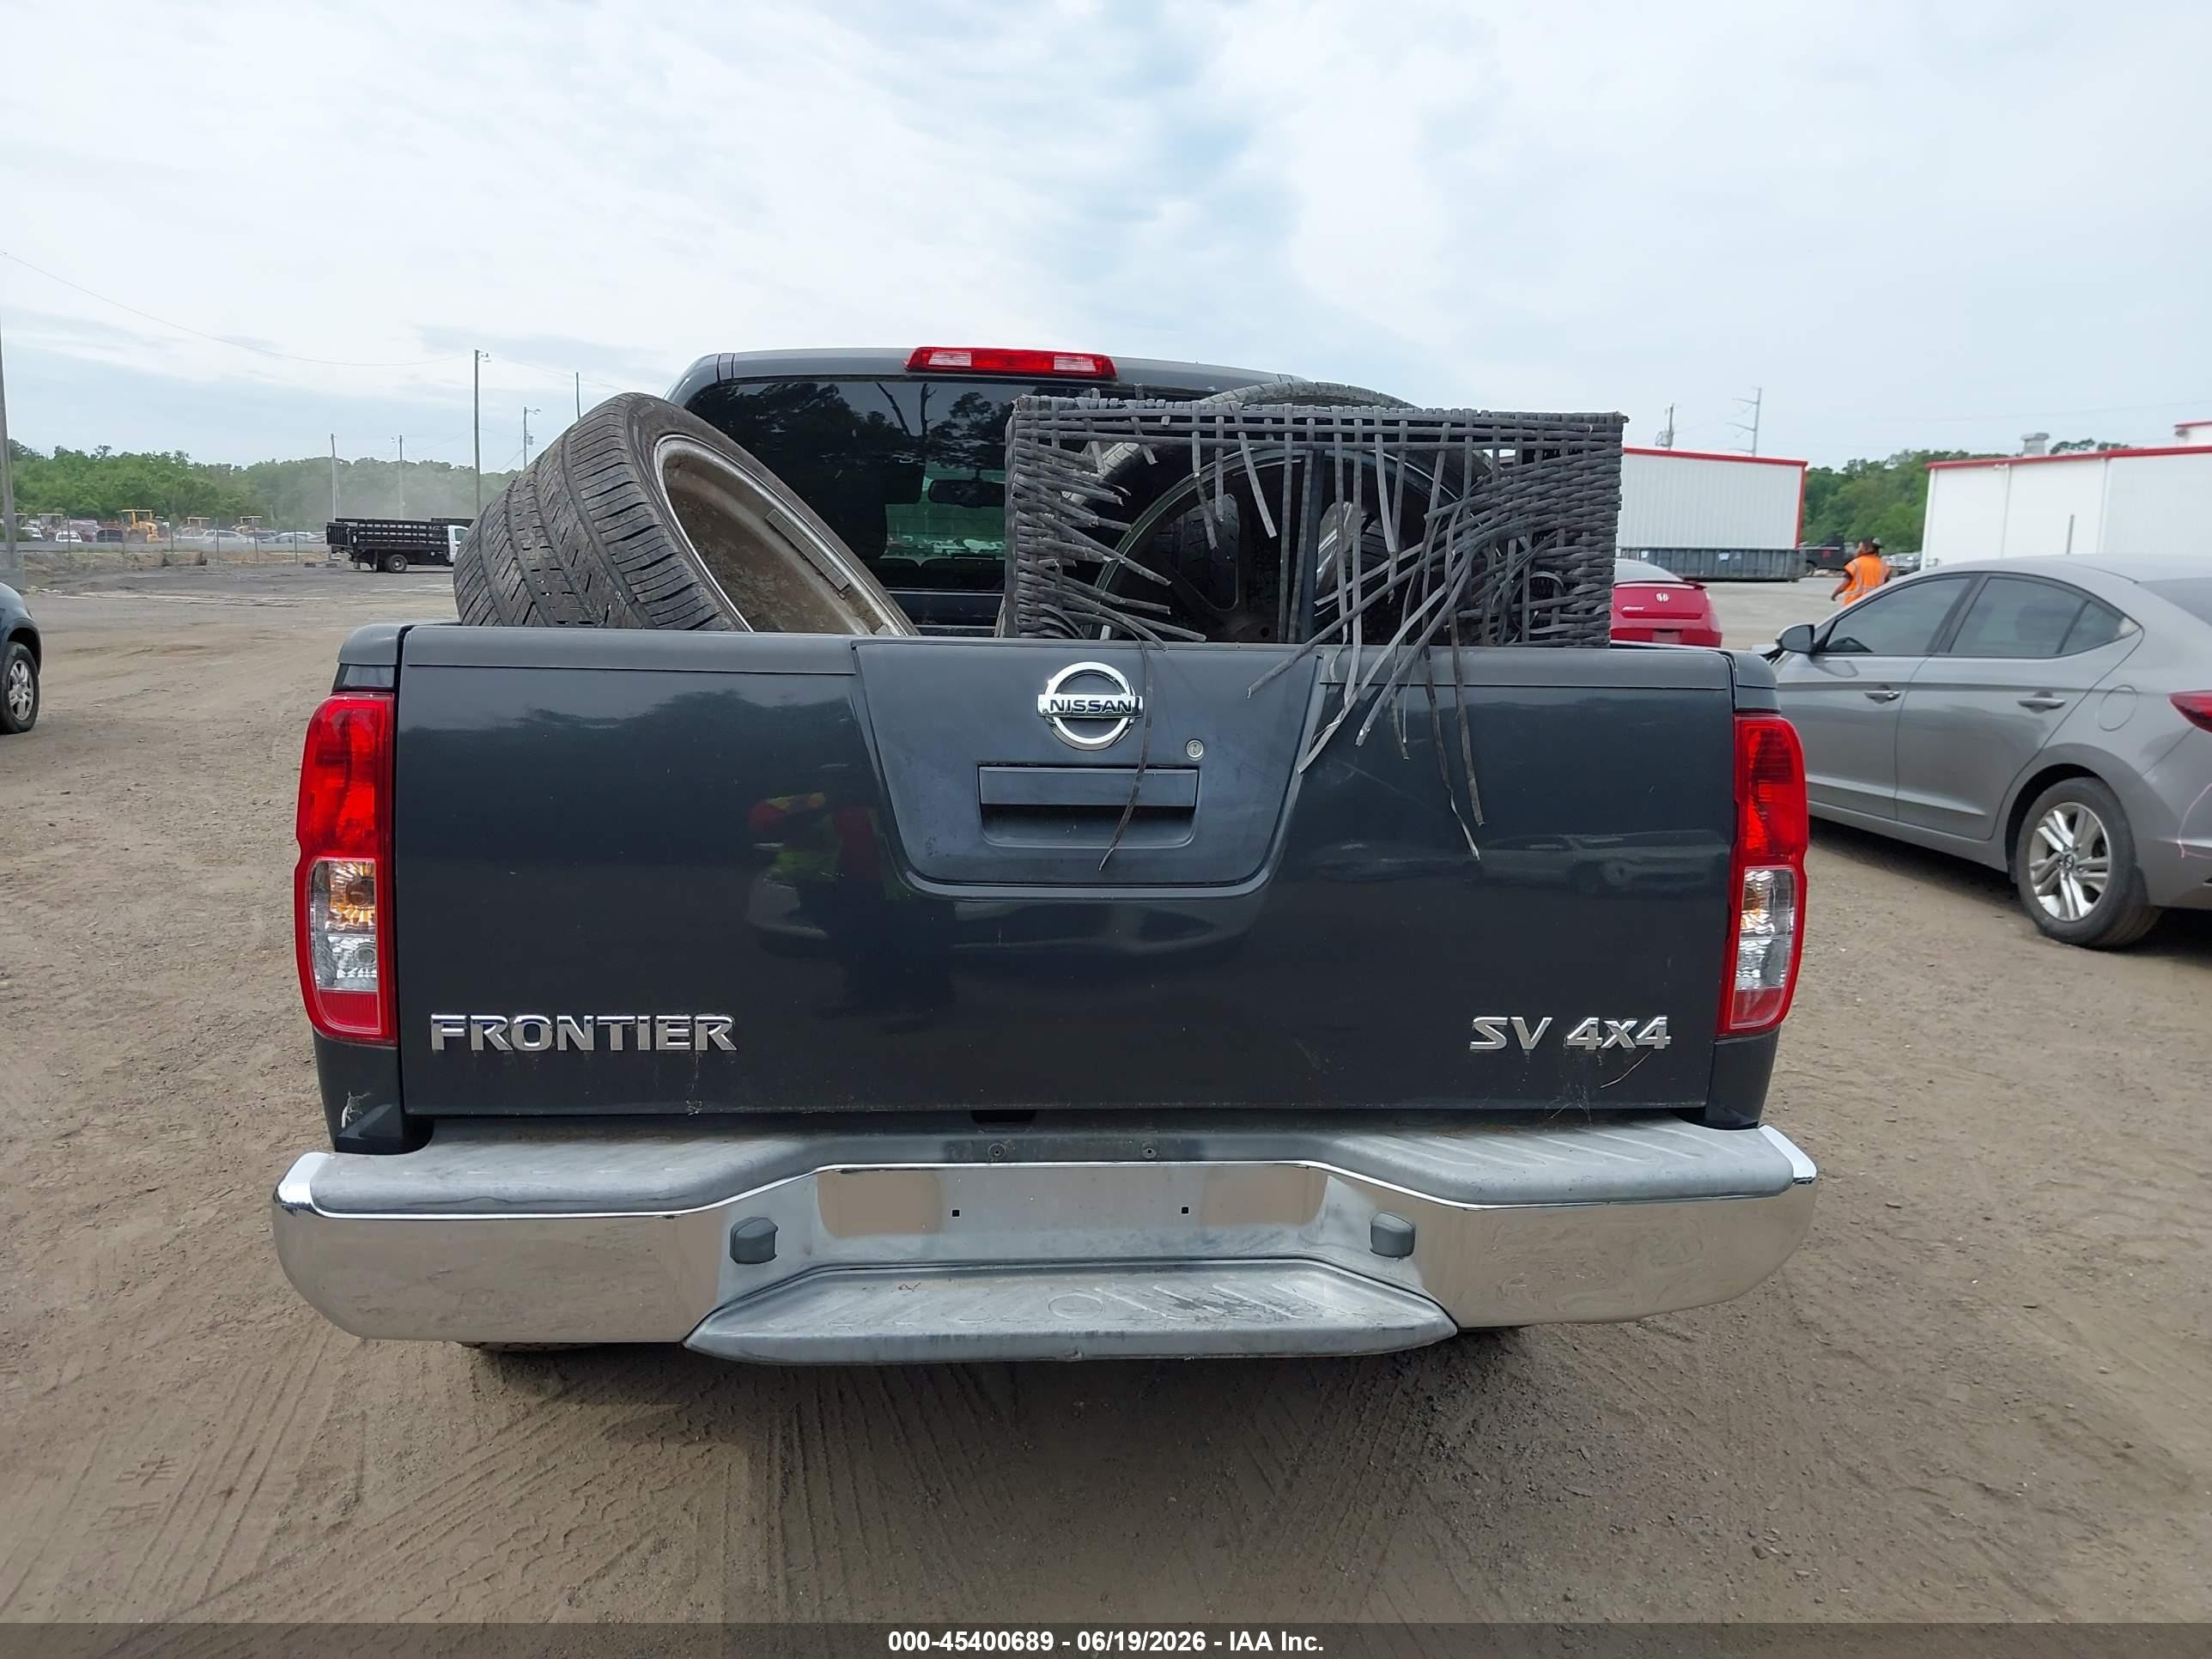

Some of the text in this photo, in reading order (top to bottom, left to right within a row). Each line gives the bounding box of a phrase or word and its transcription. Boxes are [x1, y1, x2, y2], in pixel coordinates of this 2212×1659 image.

[1050, 699, 1133, 714] NISSAN
[430, 1014, 738, 1051] FRONTIER
[1469, 1016, 1672, 1050] SV 4x4
